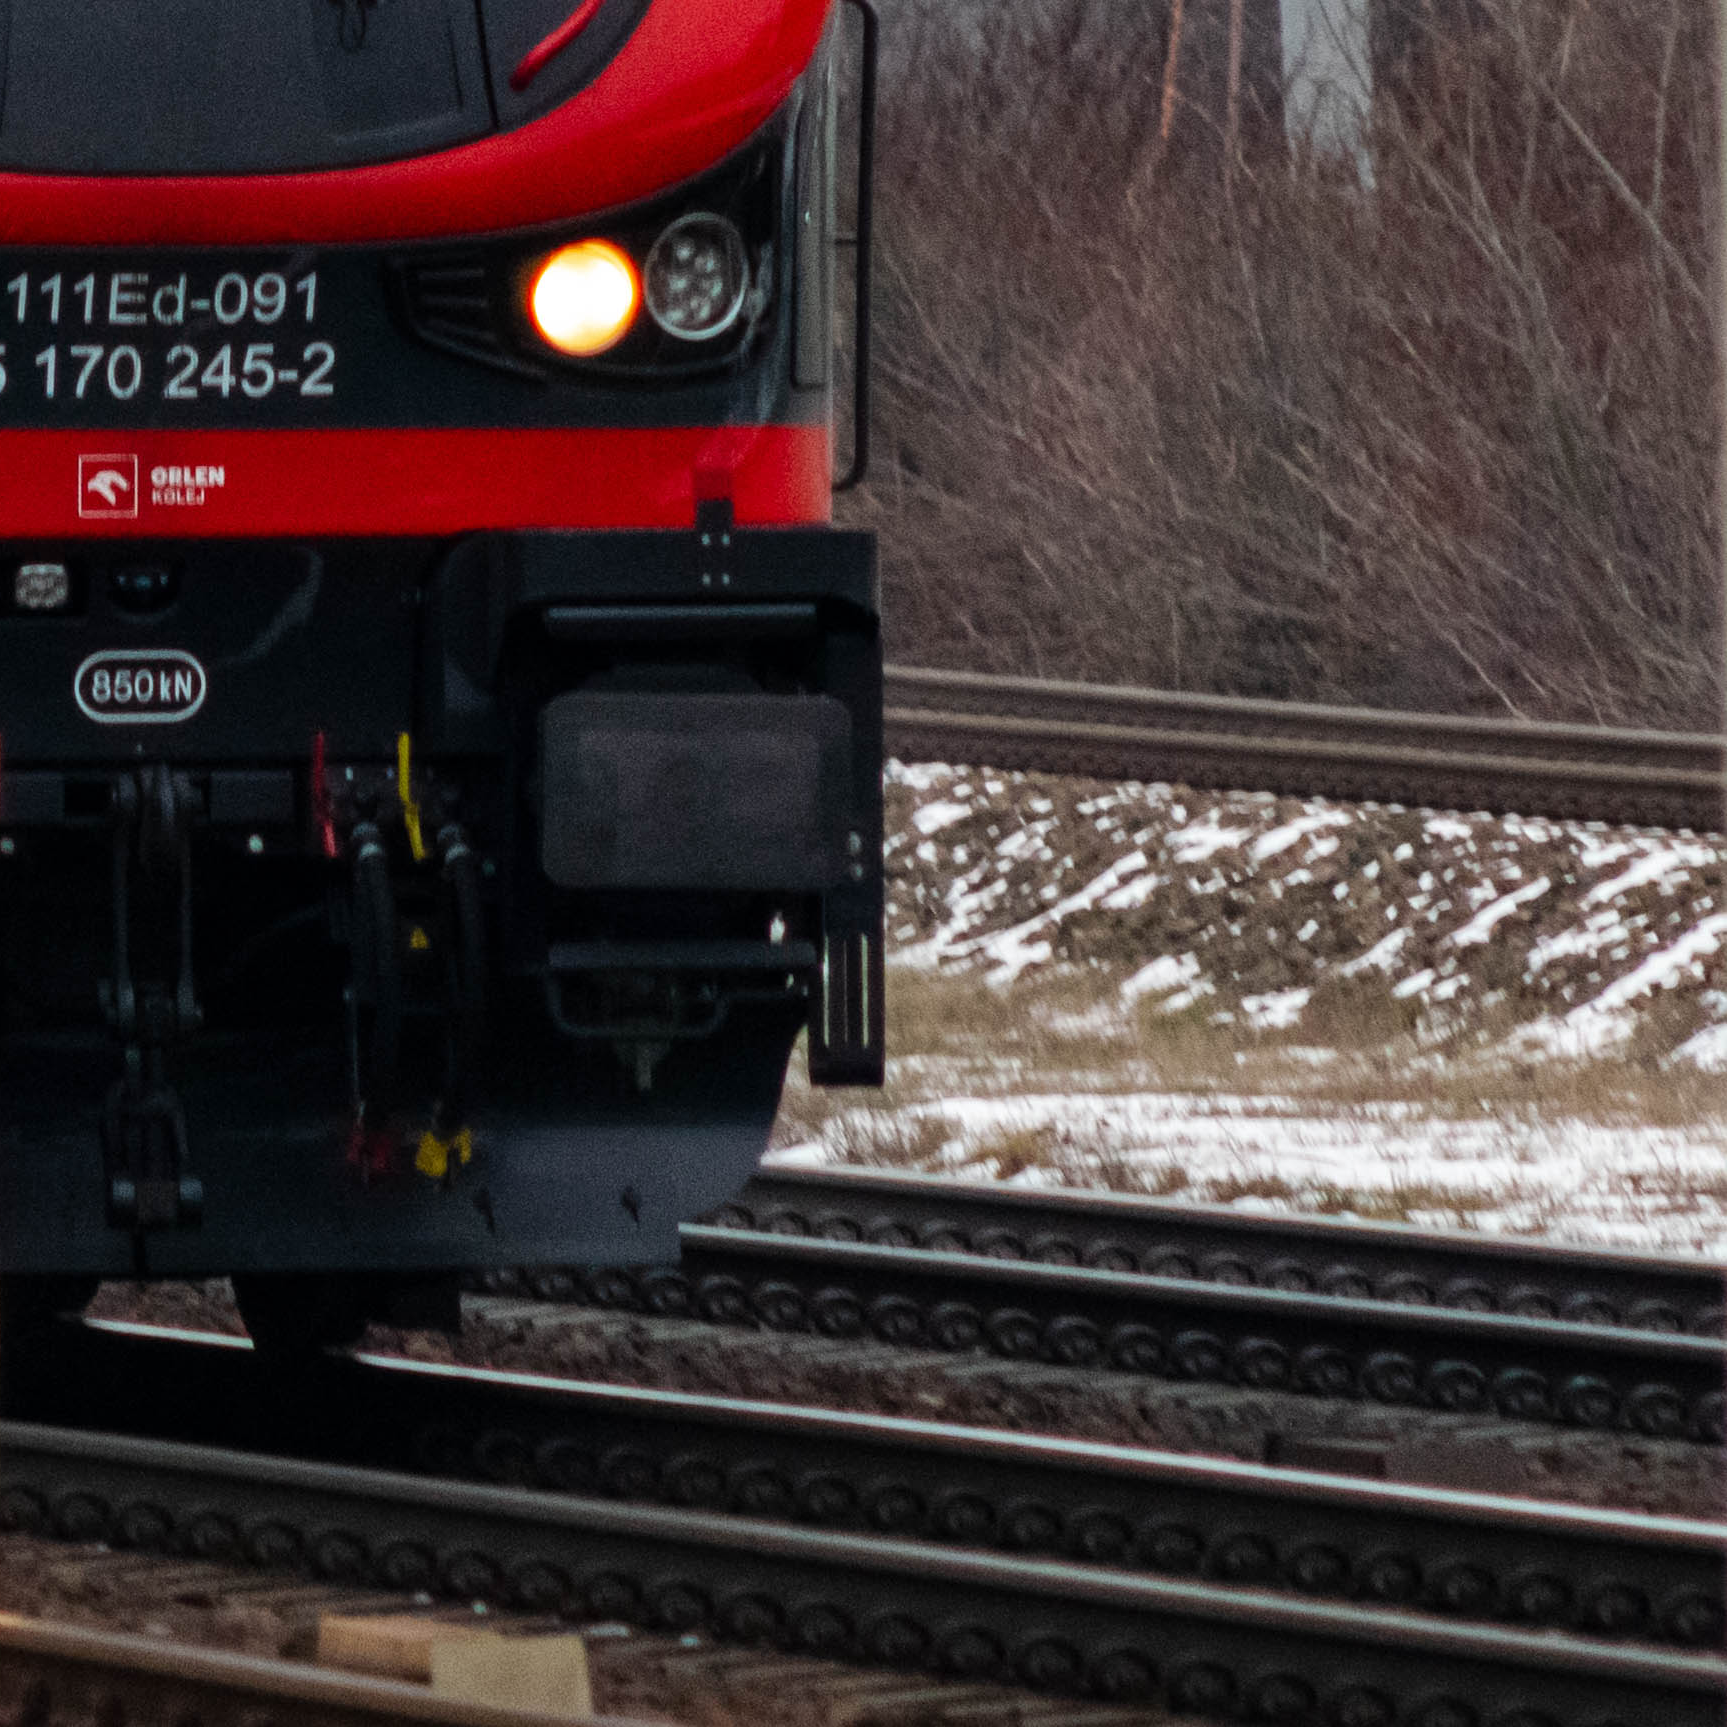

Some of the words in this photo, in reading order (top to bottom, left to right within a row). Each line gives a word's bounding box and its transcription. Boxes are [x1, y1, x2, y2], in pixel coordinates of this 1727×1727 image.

[6, 272, 319, 325] 111Ed-091
[35, 344, 143, 399] 170
[163, 342, 336, 398] 245-2
[150, 465, 226, 488] ORLEN
[151, 487, 205, 506] KOLEJ
[92, 670, 152, 704] 850
[158, 669, 193, 703] kN
